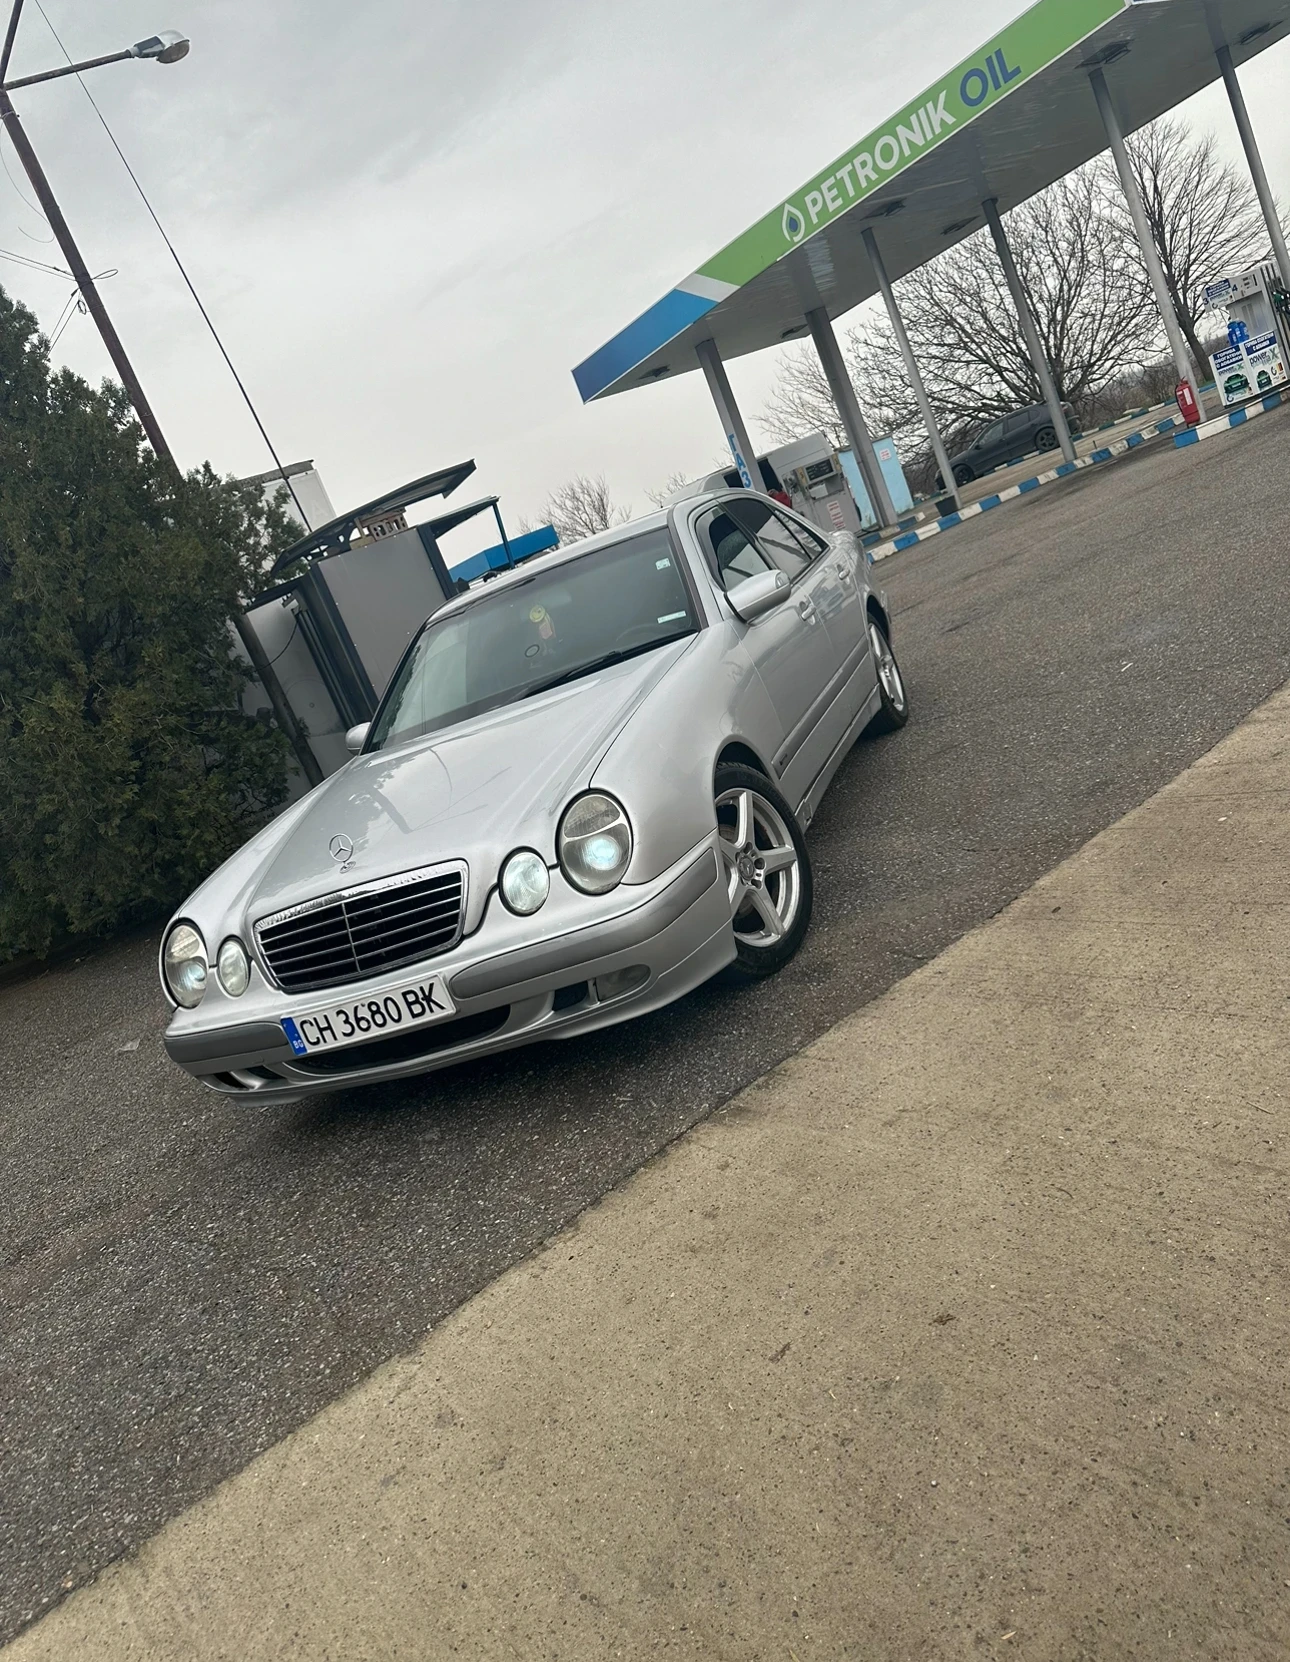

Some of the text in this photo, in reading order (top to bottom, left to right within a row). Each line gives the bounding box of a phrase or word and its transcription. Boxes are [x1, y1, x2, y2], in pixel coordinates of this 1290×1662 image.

[804, 48, 1022, 225] PETRONIK OIL
[728, 433, 751, 488] ГАЗ
[300, 982, 446, 1046] CH 3680 BK
[292, 1039, 304, 1049] BG
